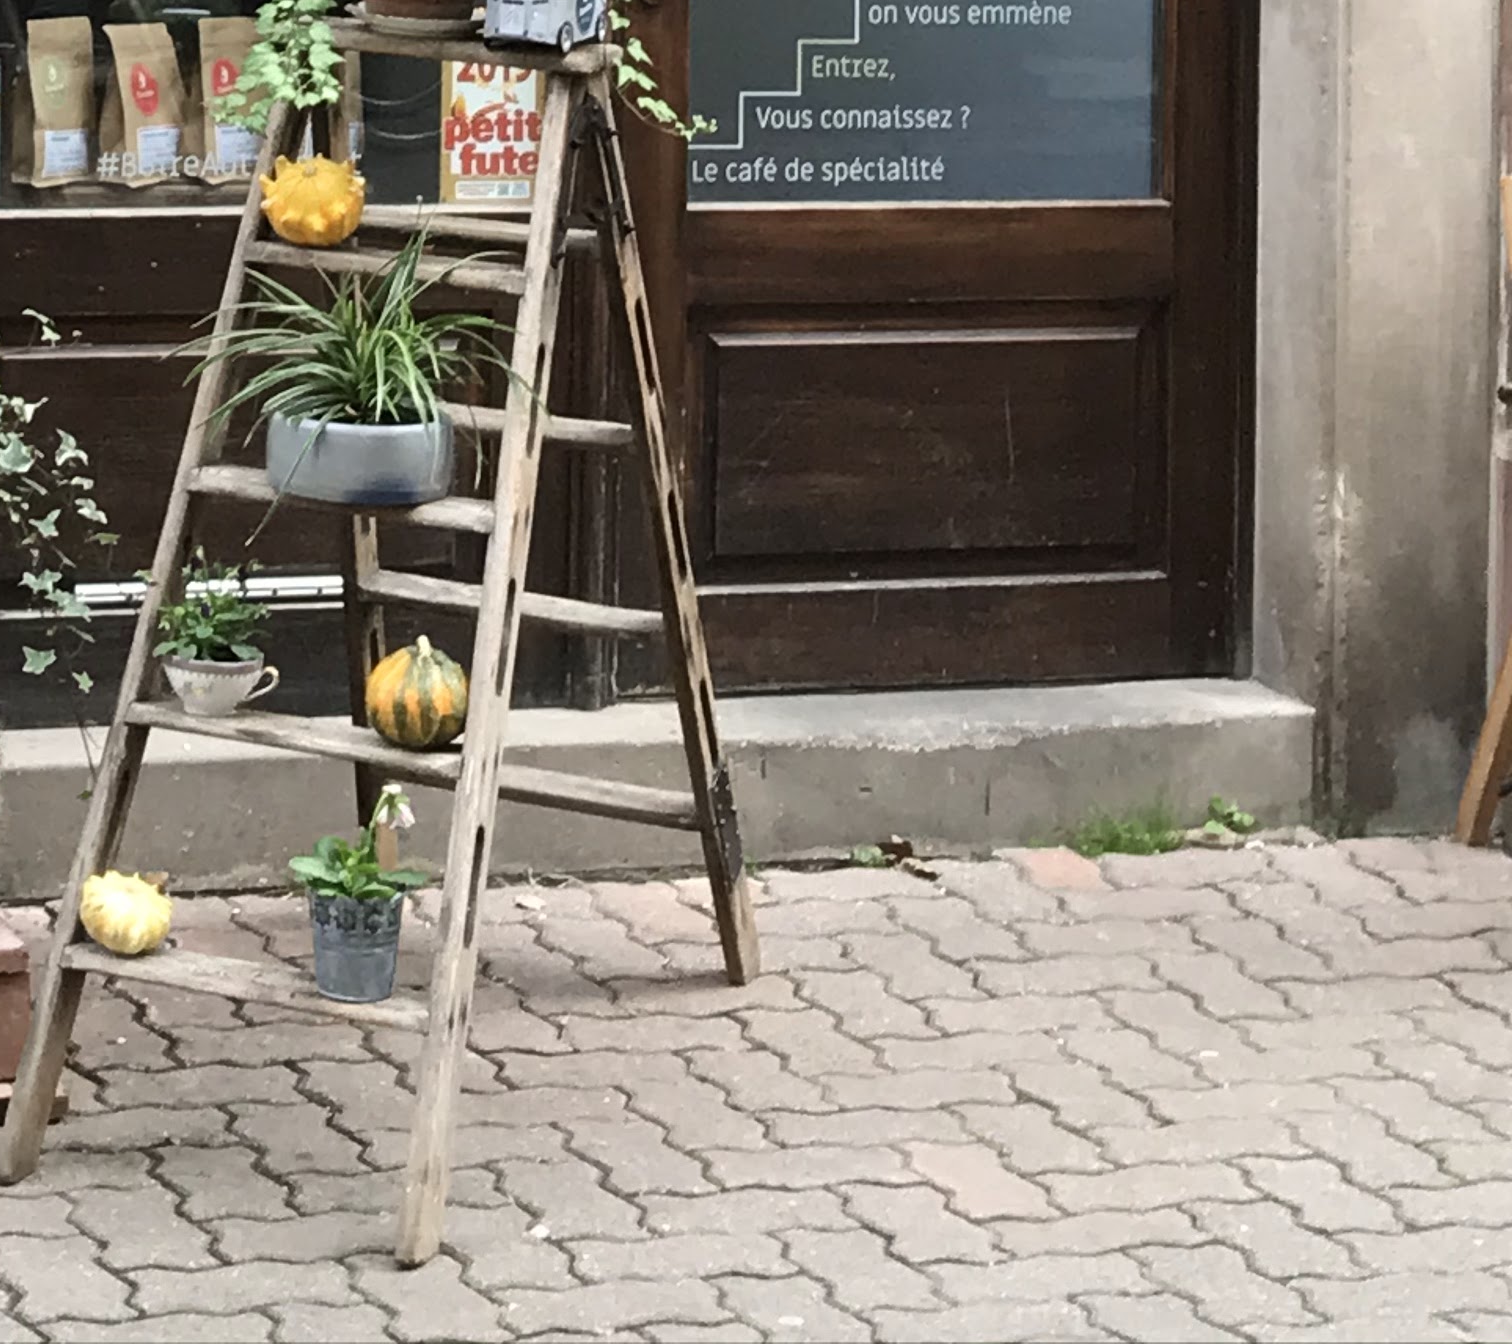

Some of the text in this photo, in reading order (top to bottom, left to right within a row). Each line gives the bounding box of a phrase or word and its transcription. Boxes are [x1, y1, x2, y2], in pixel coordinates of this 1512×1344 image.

[868, 0, 1072, 25] on vous emmène
[812, 55, 896, 81] Entrez,
[444, 109, 542, 150] petit
[756, 106, 813, 129] Vous
[820, 106, 953, 129] connaissez
[692, 157, 945, 186] Le café de spécialité
